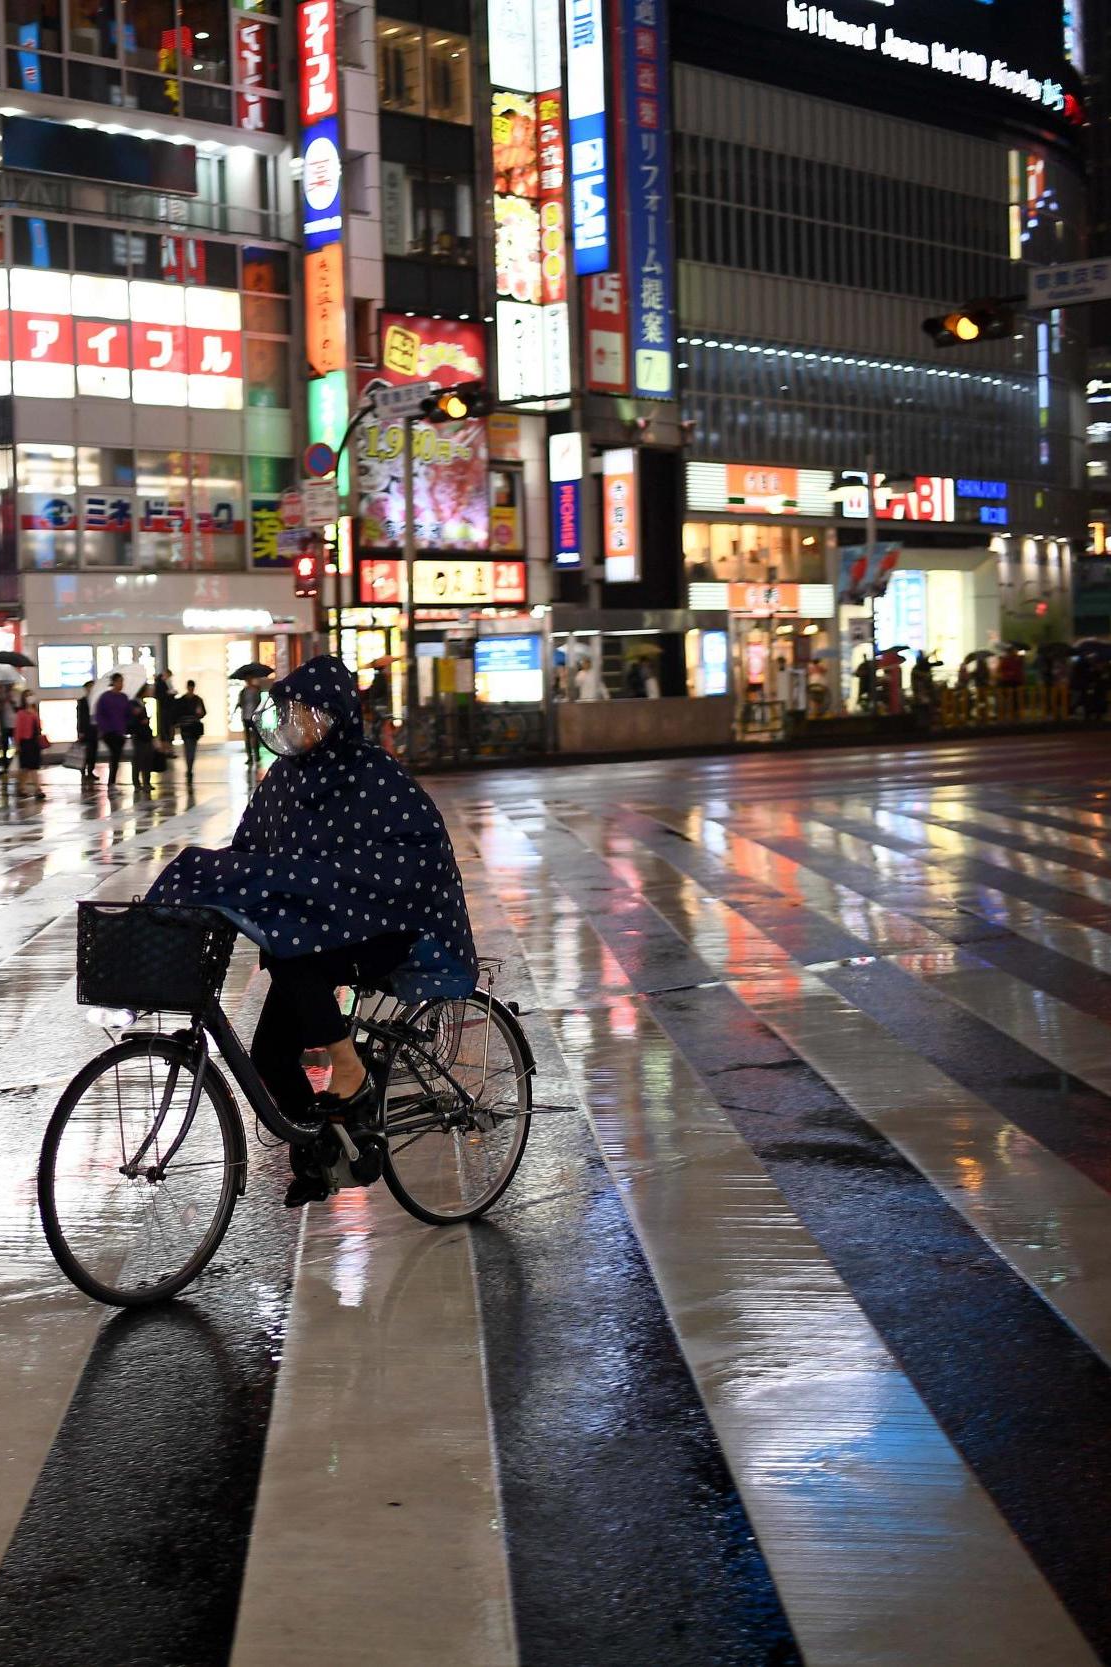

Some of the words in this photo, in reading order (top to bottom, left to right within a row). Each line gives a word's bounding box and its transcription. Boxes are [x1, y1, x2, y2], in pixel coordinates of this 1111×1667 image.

[304, 1, 333, 116] アイフル
[27, 319, 233, 374] アイフル
[560, 484, 577, 548] PROMISE
